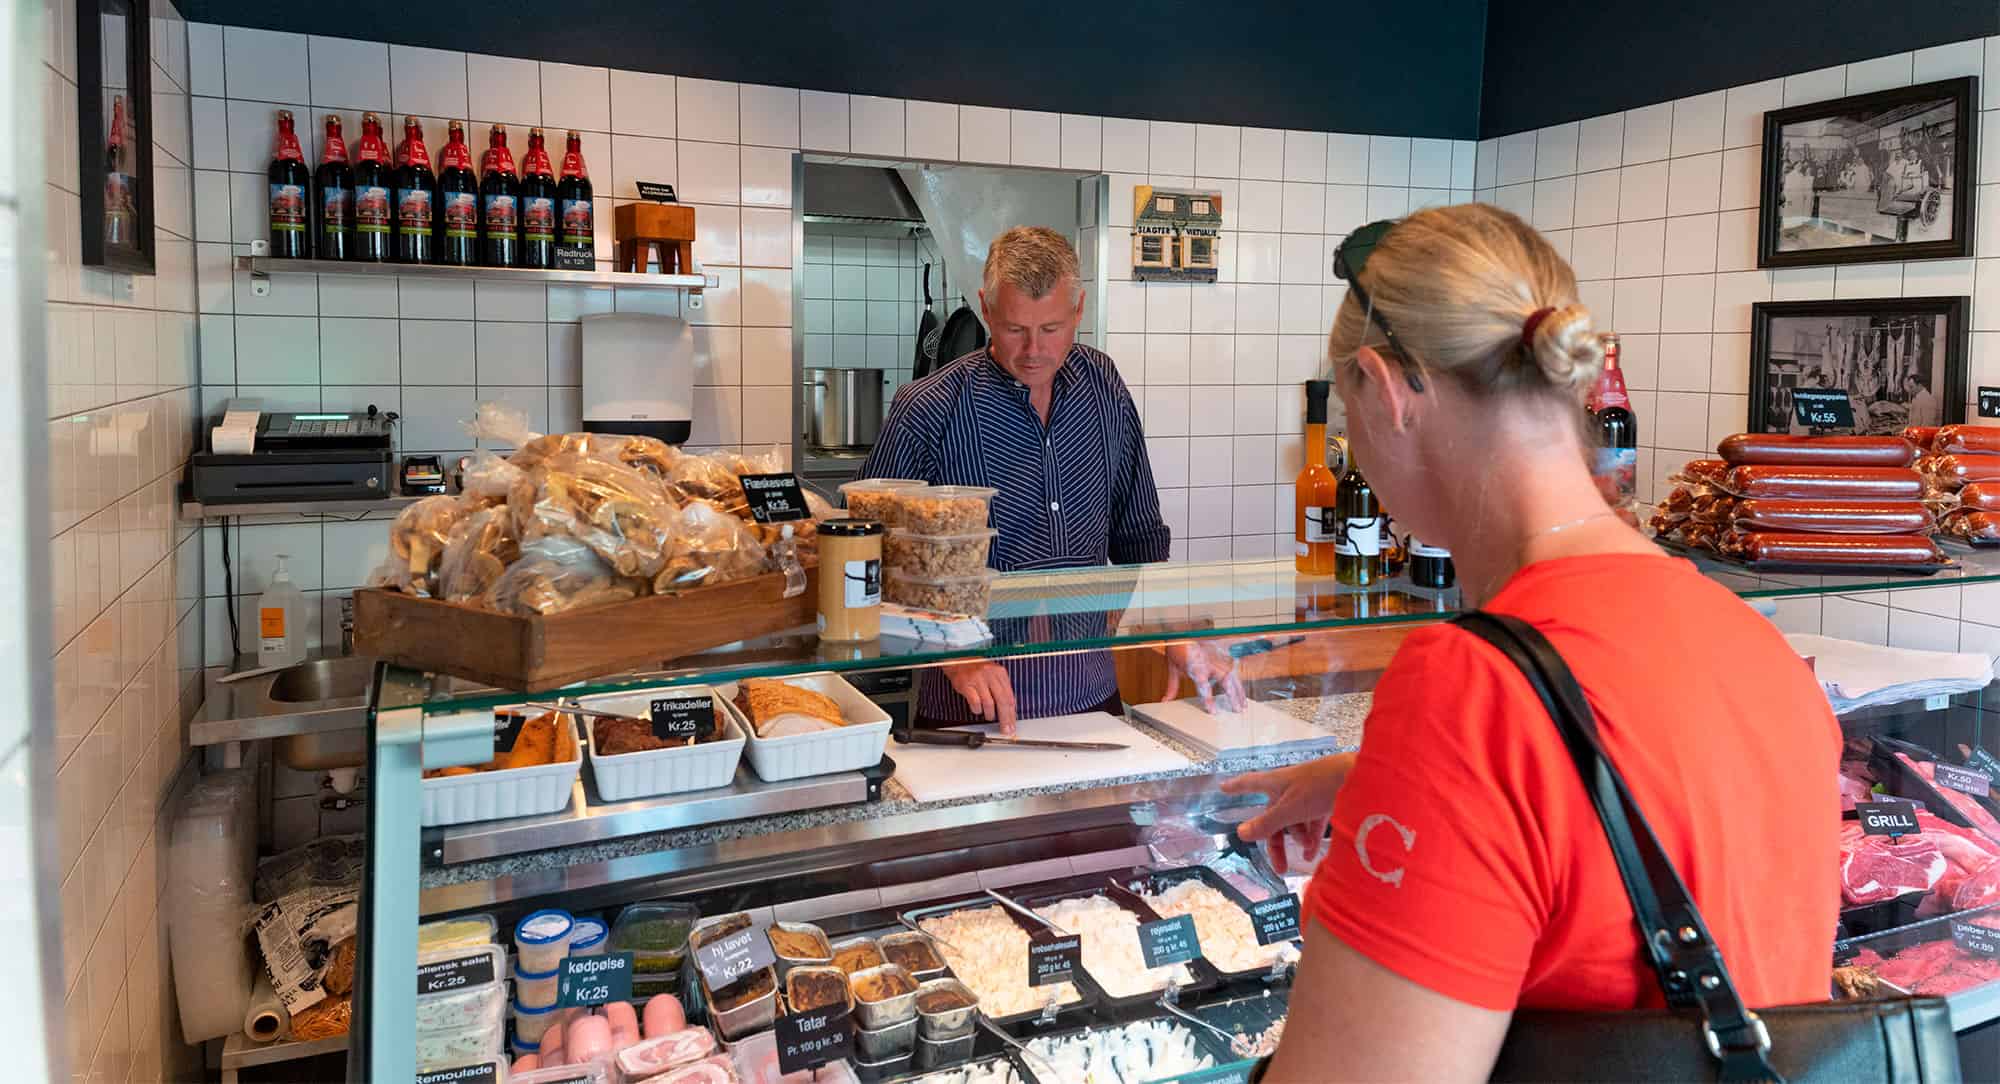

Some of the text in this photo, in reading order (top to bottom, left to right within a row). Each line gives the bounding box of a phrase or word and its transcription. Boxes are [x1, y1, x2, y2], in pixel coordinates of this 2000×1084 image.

[653, 700, 711, 712] 2 frikadeller
[668, 720, 696, 732] Kr.25
[1867, 815, 1914, 828] GRILL
[1354, 813, 1416, 888] C
[568, 957, 625, 975] kødpølse
[576, 985, 609, 1001] Kr.25
[796, 1016, 828, 1033] Tatar
